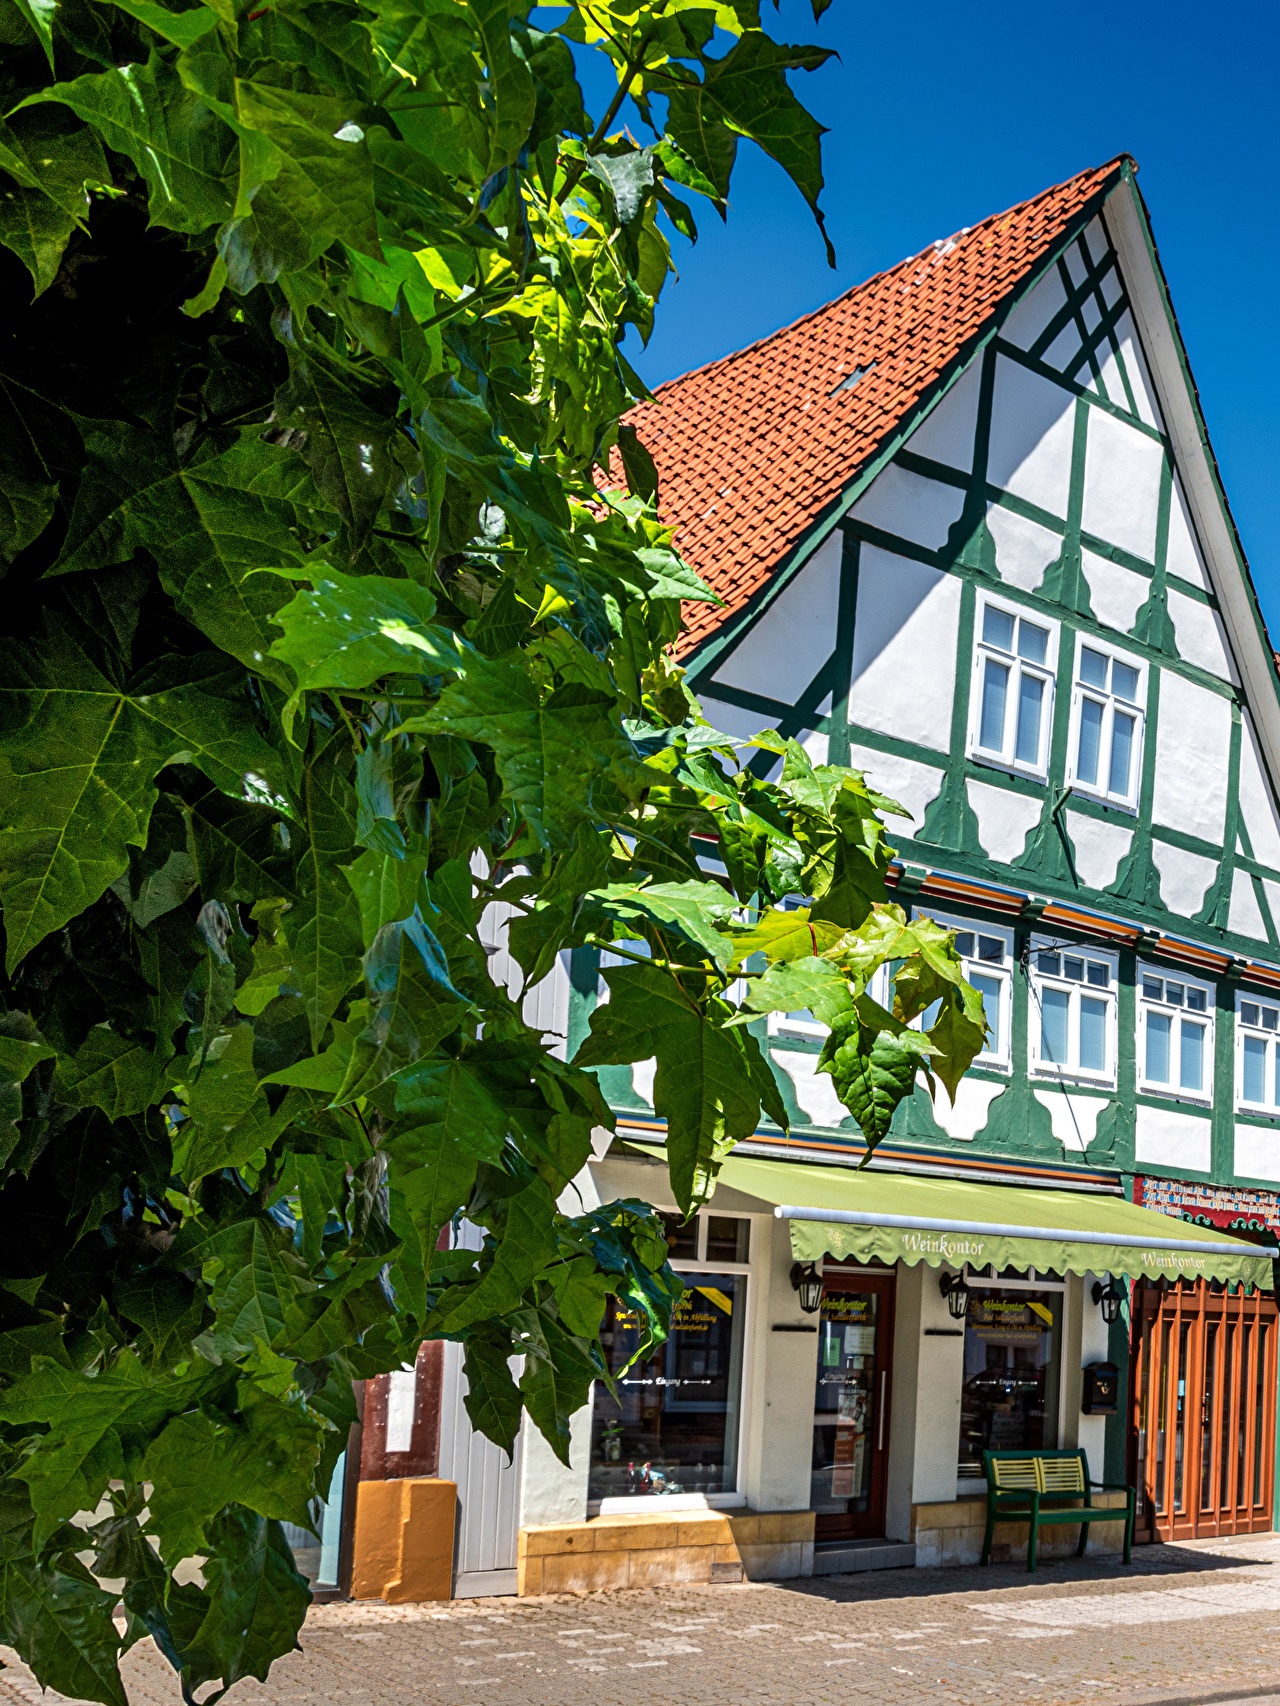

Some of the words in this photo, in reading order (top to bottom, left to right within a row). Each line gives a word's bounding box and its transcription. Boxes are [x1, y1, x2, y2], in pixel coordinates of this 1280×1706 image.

[902, 1233, 984, 1258] Weinkontor
[1141, 1251, 1206, 1271] Weinkontor
[821, 1297, 868, 1313] Weinkontor
[983, 1299, 1026, 1313] Weinkontor
[655, 1377, 681, 1387] Eingang
[998, 1378, 1017, 1387] Eingang
